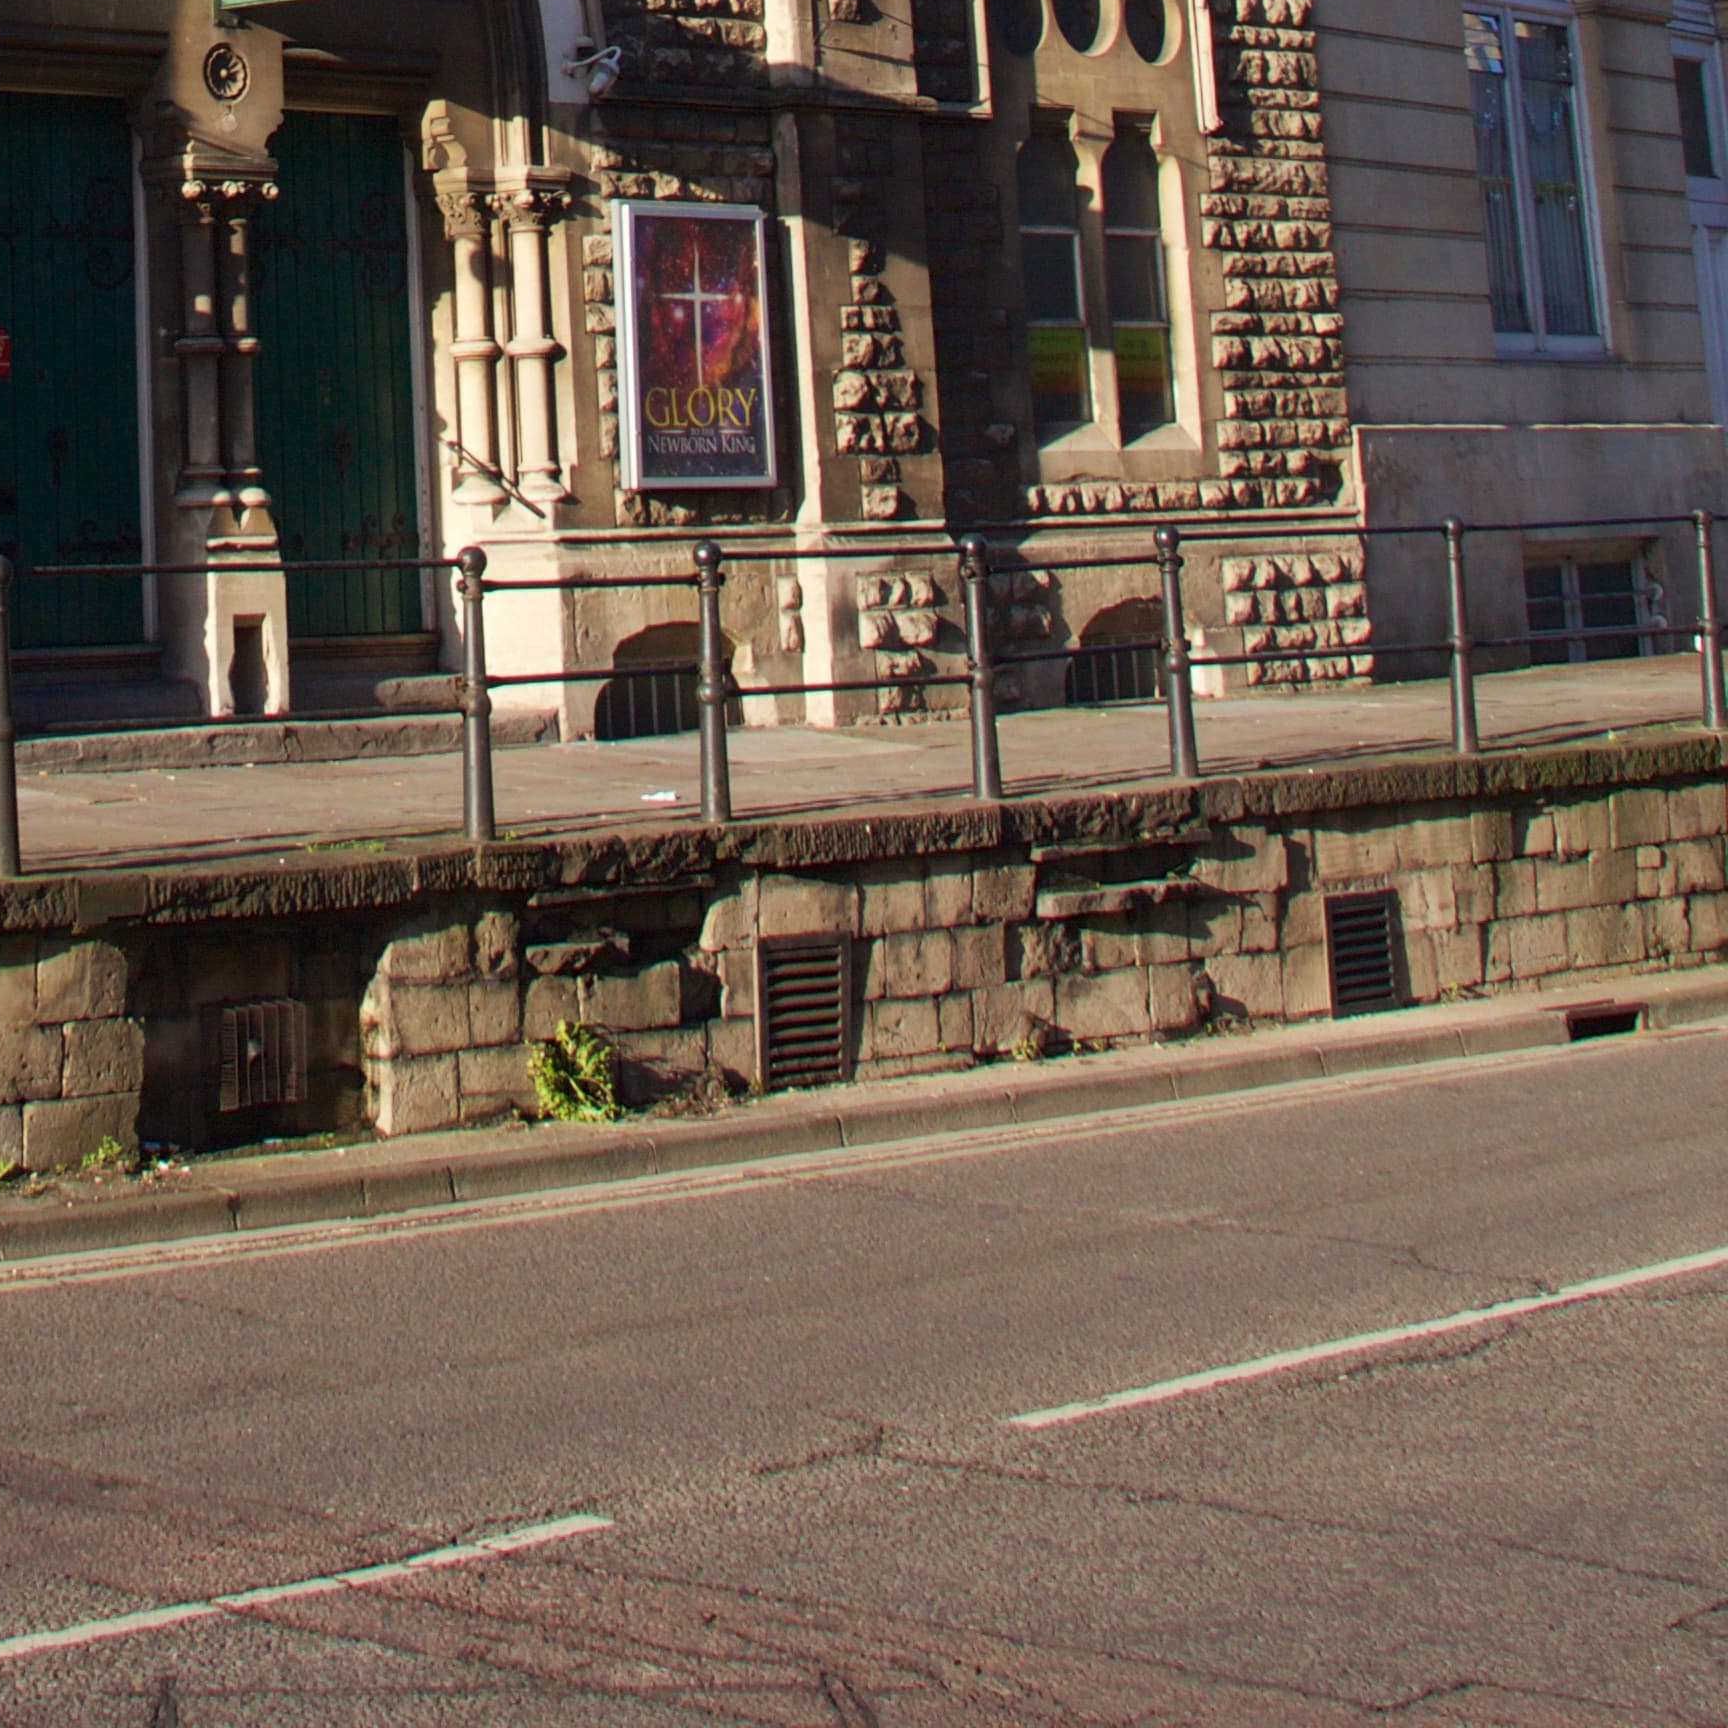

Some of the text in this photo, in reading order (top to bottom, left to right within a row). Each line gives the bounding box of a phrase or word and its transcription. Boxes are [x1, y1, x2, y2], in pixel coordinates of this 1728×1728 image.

[645, 385, 757, 428] GLORY
[648, 434, 757, 455] NEWBORN KING
